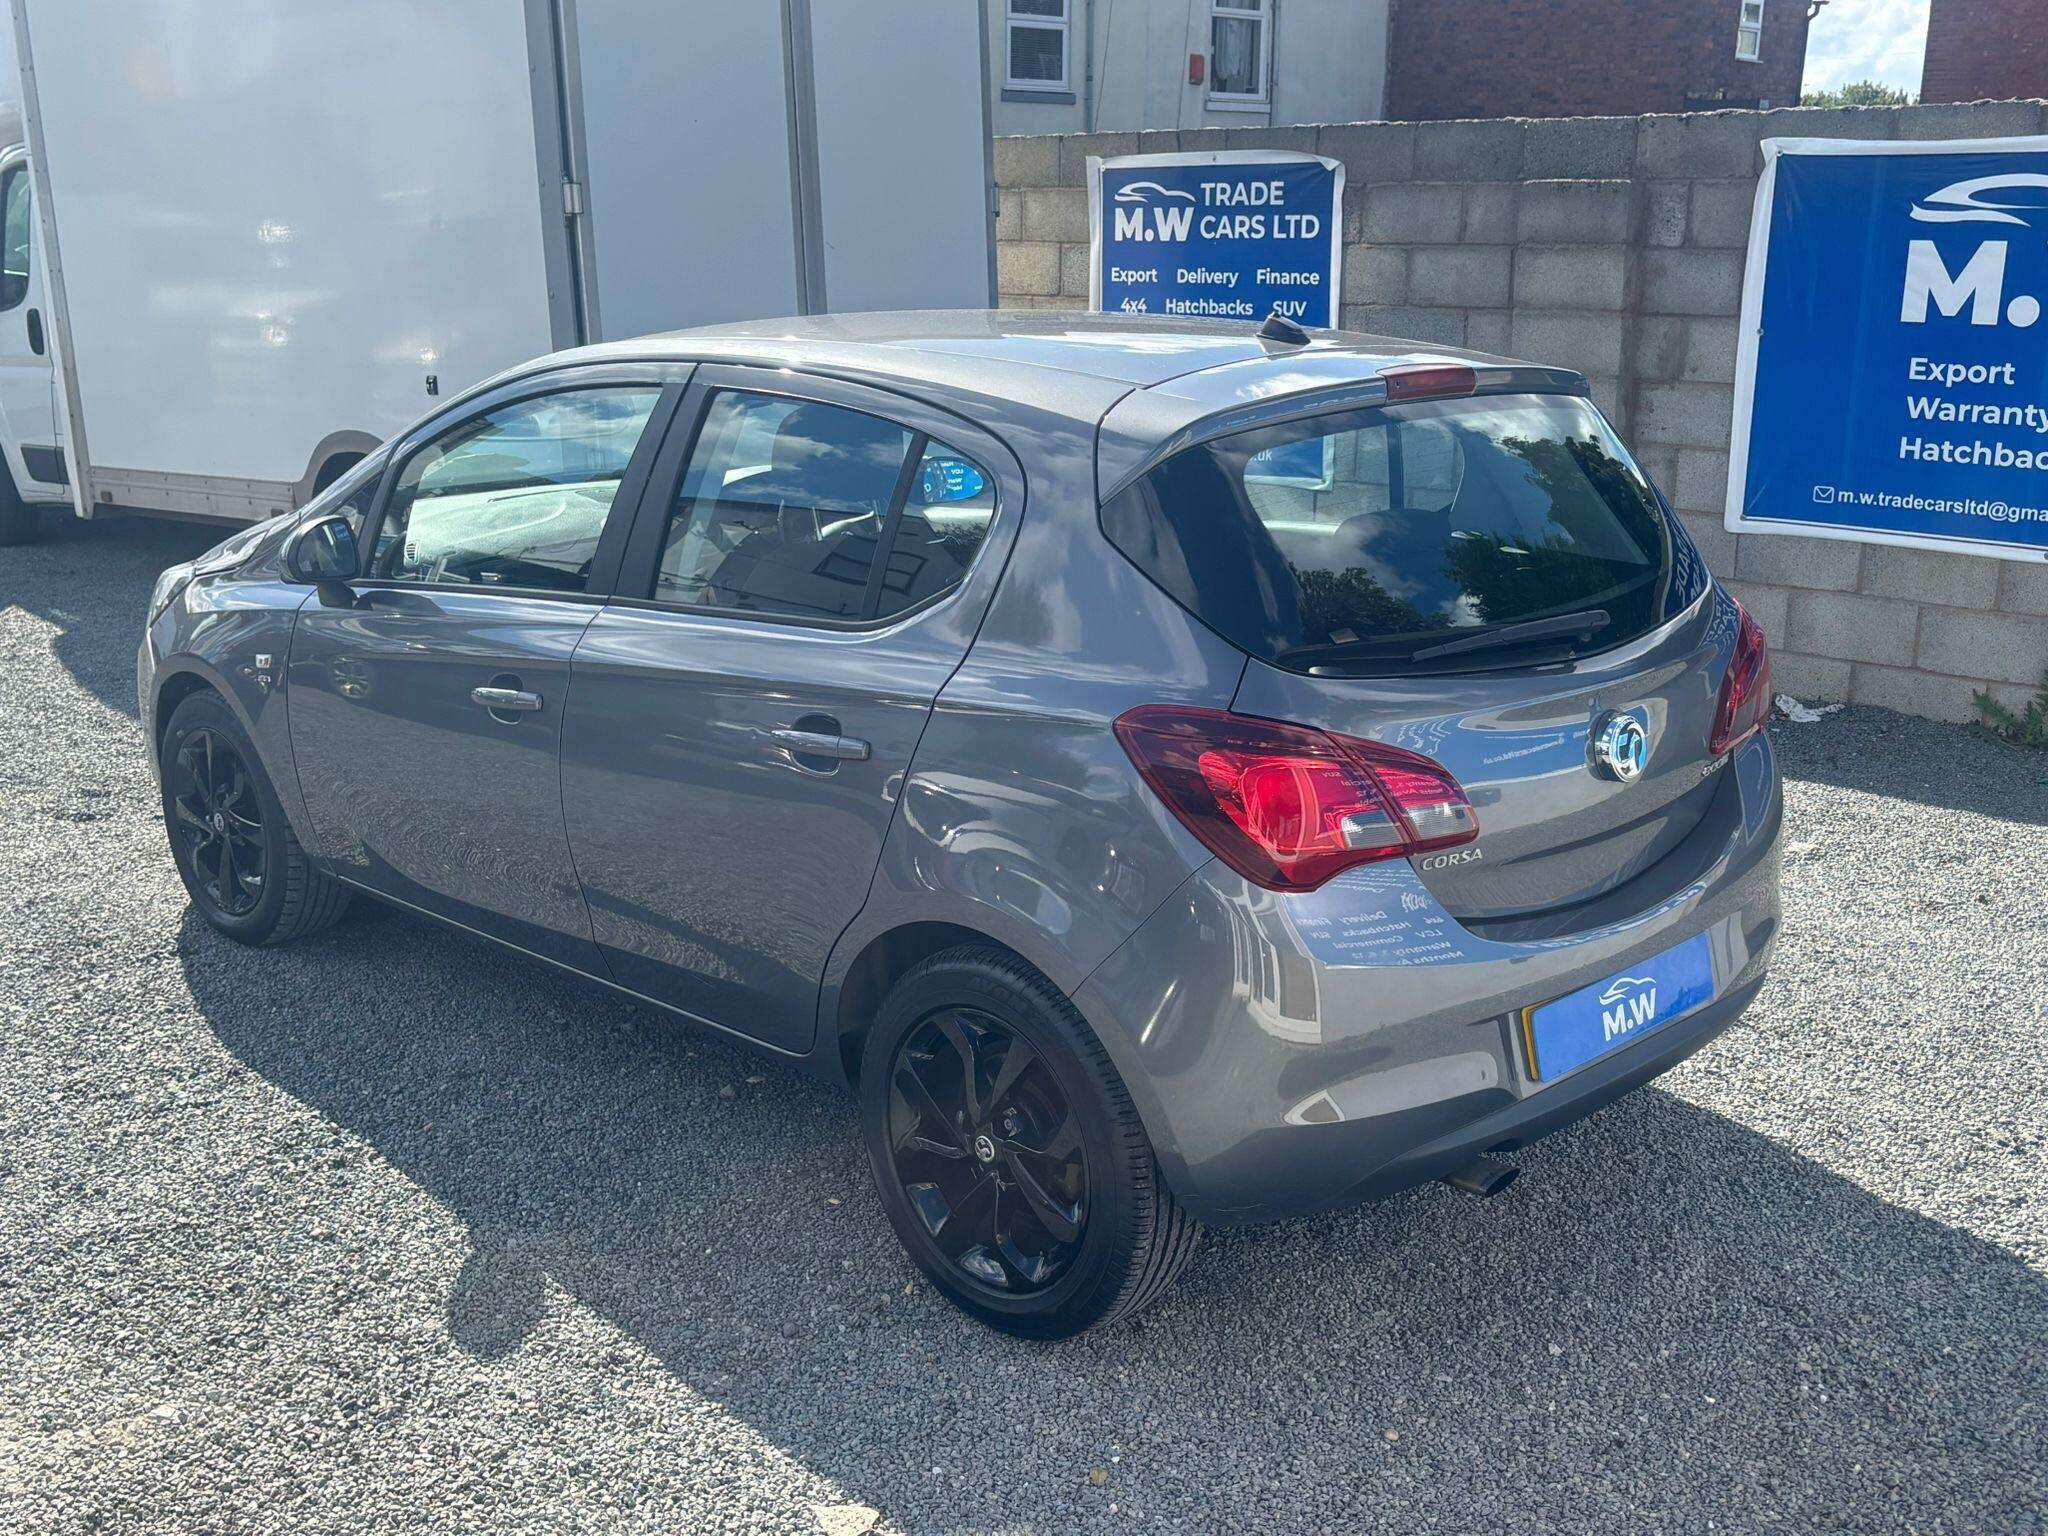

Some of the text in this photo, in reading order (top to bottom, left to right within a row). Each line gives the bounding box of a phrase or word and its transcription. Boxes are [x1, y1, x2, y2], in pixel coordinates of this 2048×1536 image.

[1200, 181, 1285, 206] TRADE
[1114, 207, 1194, 242] M.W
[1199, 214, 1320, 240] CARS LTD
[1111, 267, 1320, 288] Export Delivery Finance
[1120, 297, 1307, 316] 4x4 Hatchbacks SUV
[1909, 356, 2015, 387] Export
[1906, 396, 2048, 434] Warranty
[1899, 436, 2048, 471] Hatchbac
[1422, 848, 1484, 871] CORSA
[1602, 988, 1657, 1042] M.W
